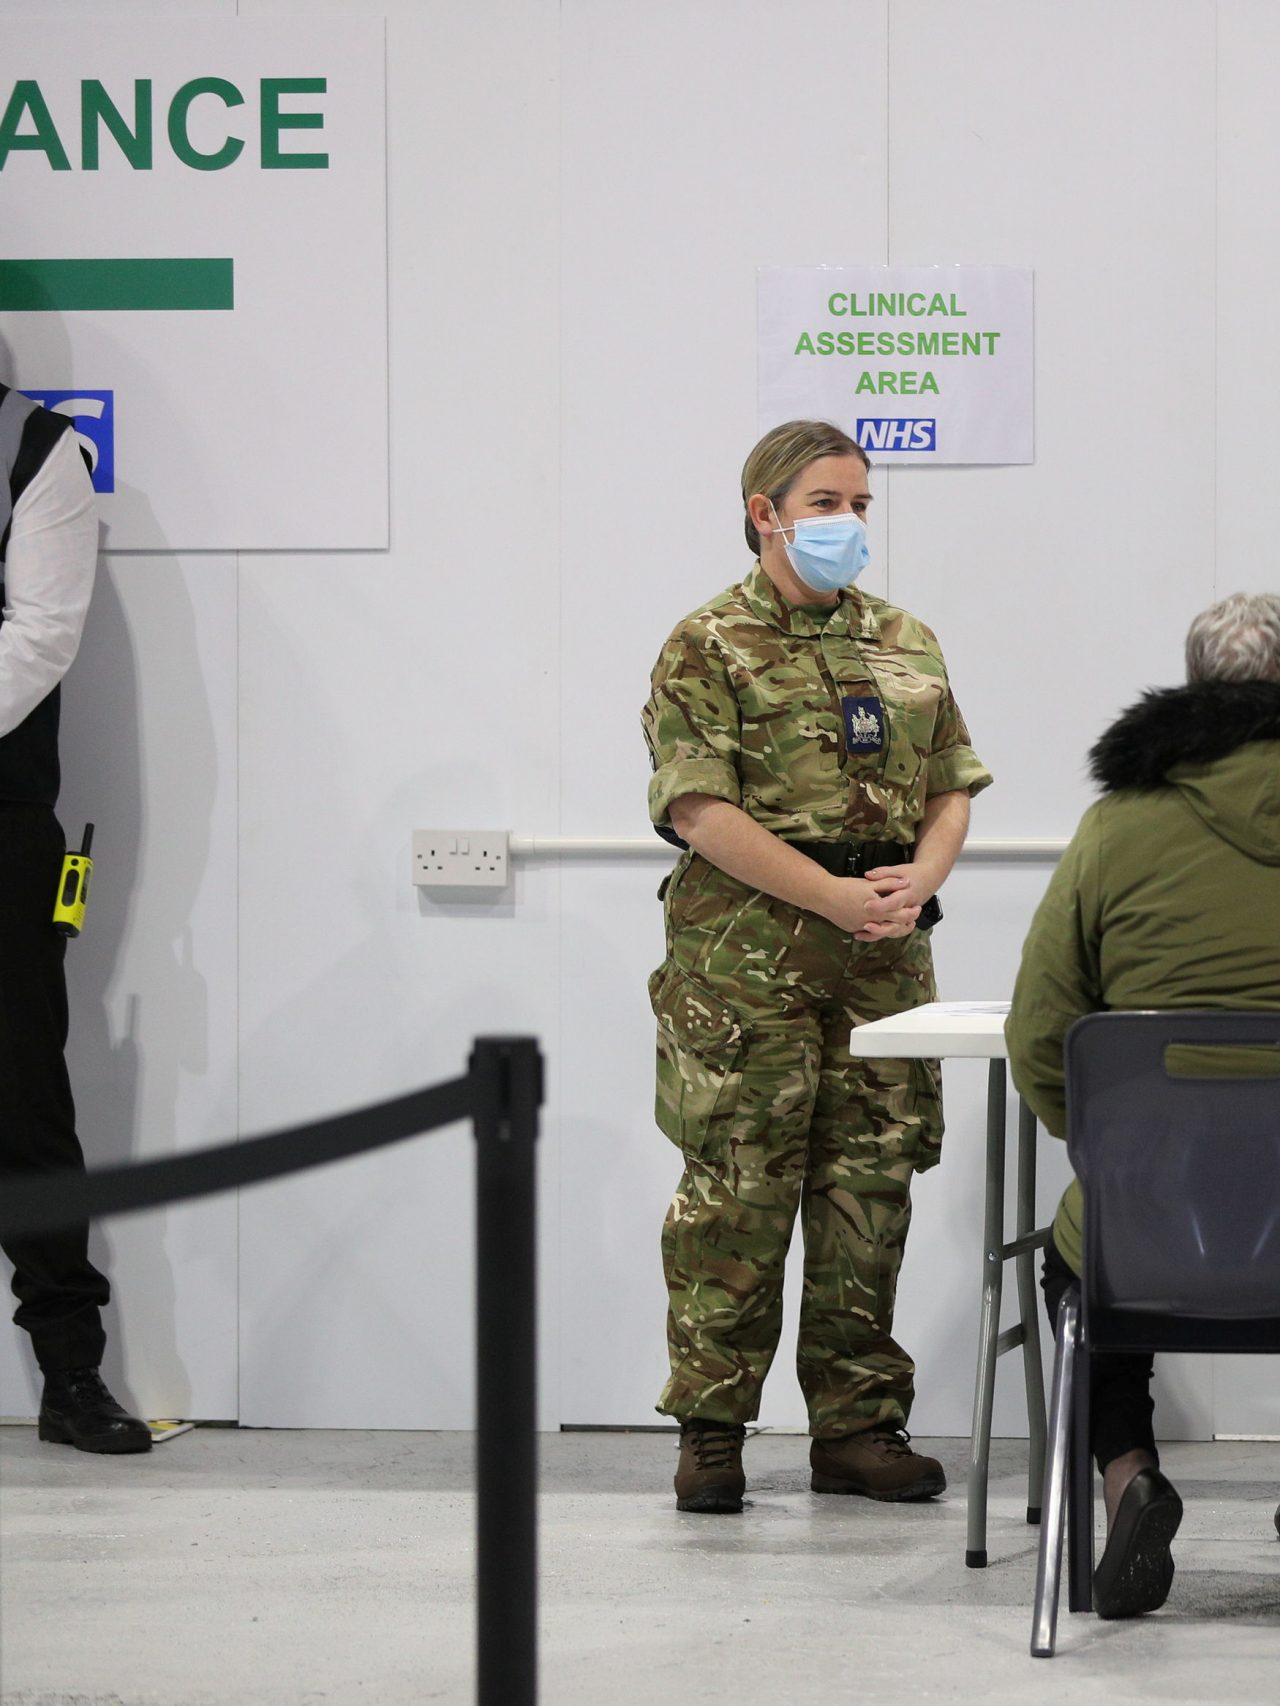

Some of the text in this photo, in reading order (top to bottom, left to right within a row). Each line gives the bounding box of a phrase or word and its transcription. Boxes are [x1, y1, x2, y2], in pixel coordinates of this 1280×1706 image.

[0, 77, 329, 171] ANCE
[828, 293, 967, 316] CLINICAL
[794, 332, 1000, 355] ASSESSMENT
[855, 372, 940, 395] AREA
[859, 421, 933, 448] NHS
